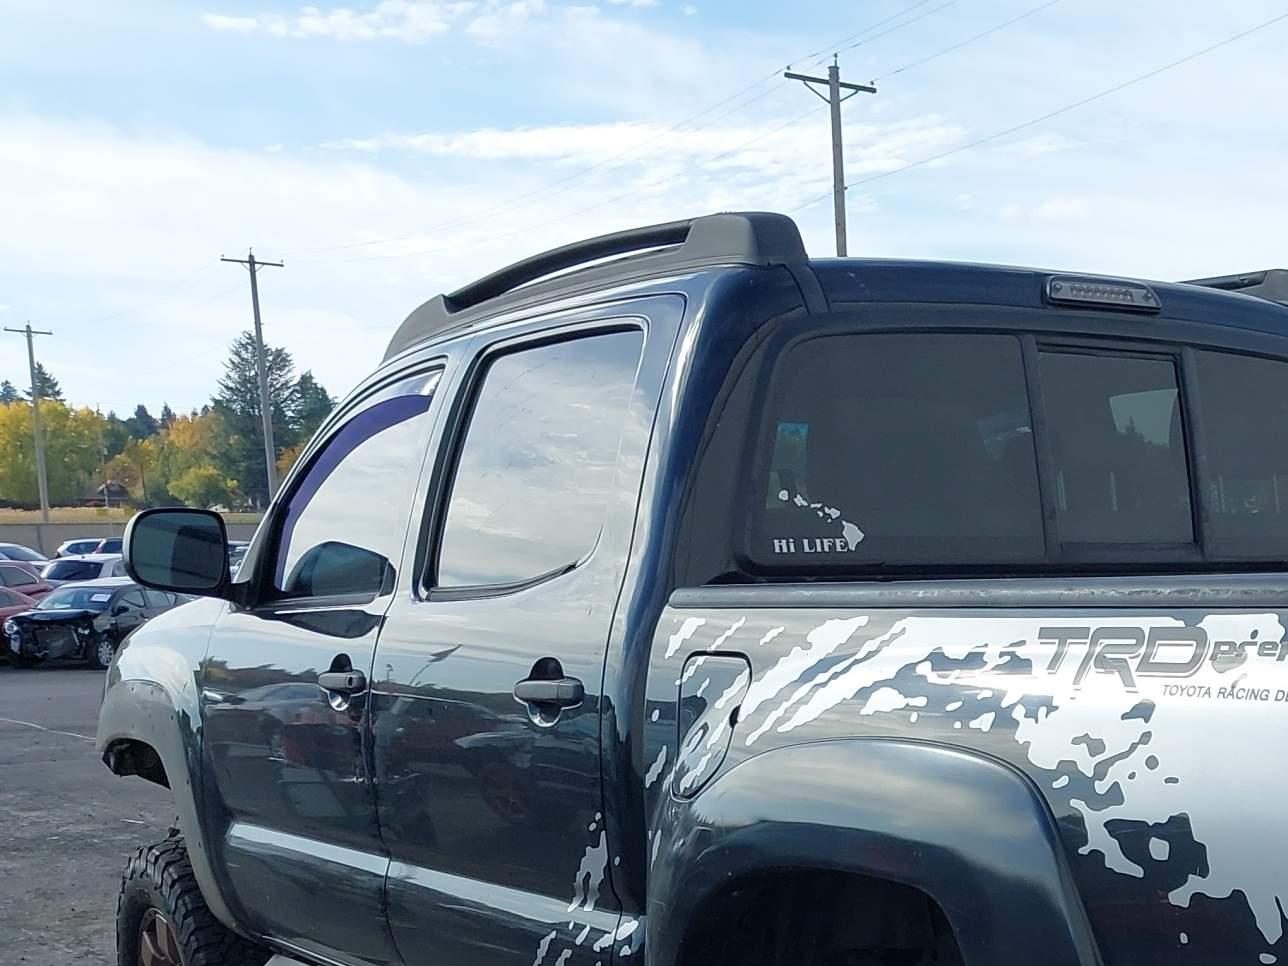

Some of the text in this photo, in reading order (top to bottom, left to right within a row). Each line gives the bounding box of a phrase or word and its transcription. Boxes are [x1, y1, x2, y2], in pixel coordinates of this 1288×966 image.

[773, 538, 849, 553] Hi LIFE
[1038, 626, 1209, 694] TRD
[1162, 684, 1212, 699] TOYOTA
[1216, 686, 1271, 701] RACING
